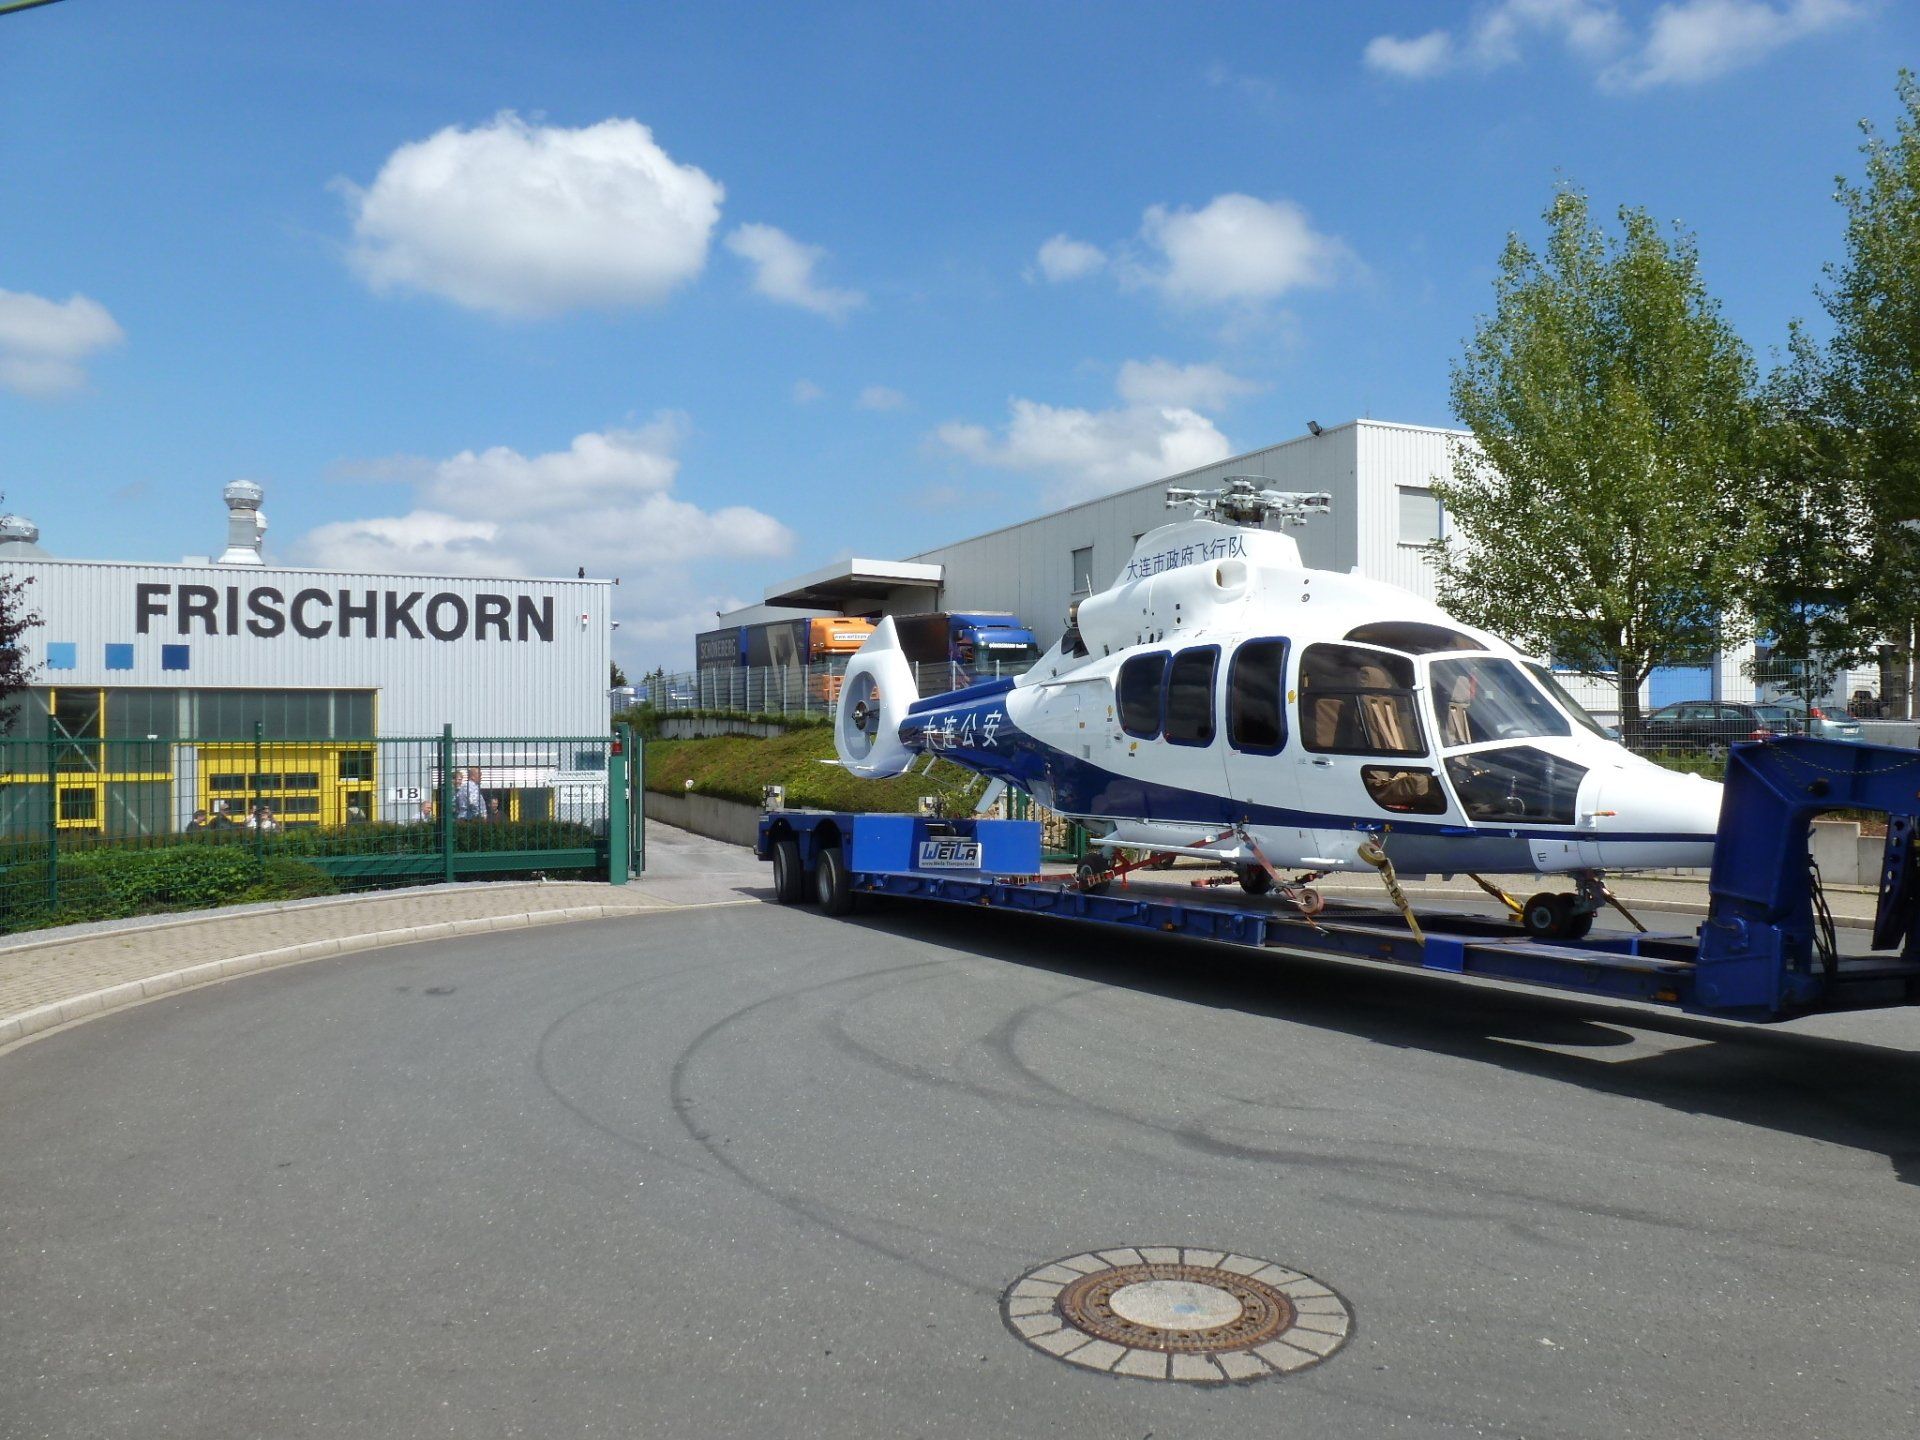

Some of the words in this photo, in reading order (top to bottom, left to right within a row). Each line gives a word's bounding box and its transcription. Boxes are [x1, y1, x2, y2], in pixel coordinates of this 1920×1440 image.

[1126, 534, 1247, 581] 大连市政府飞行队
[136, 582, 554, 642] FRISCHKORN
[923, 709, 1002, 751] 大连公安
